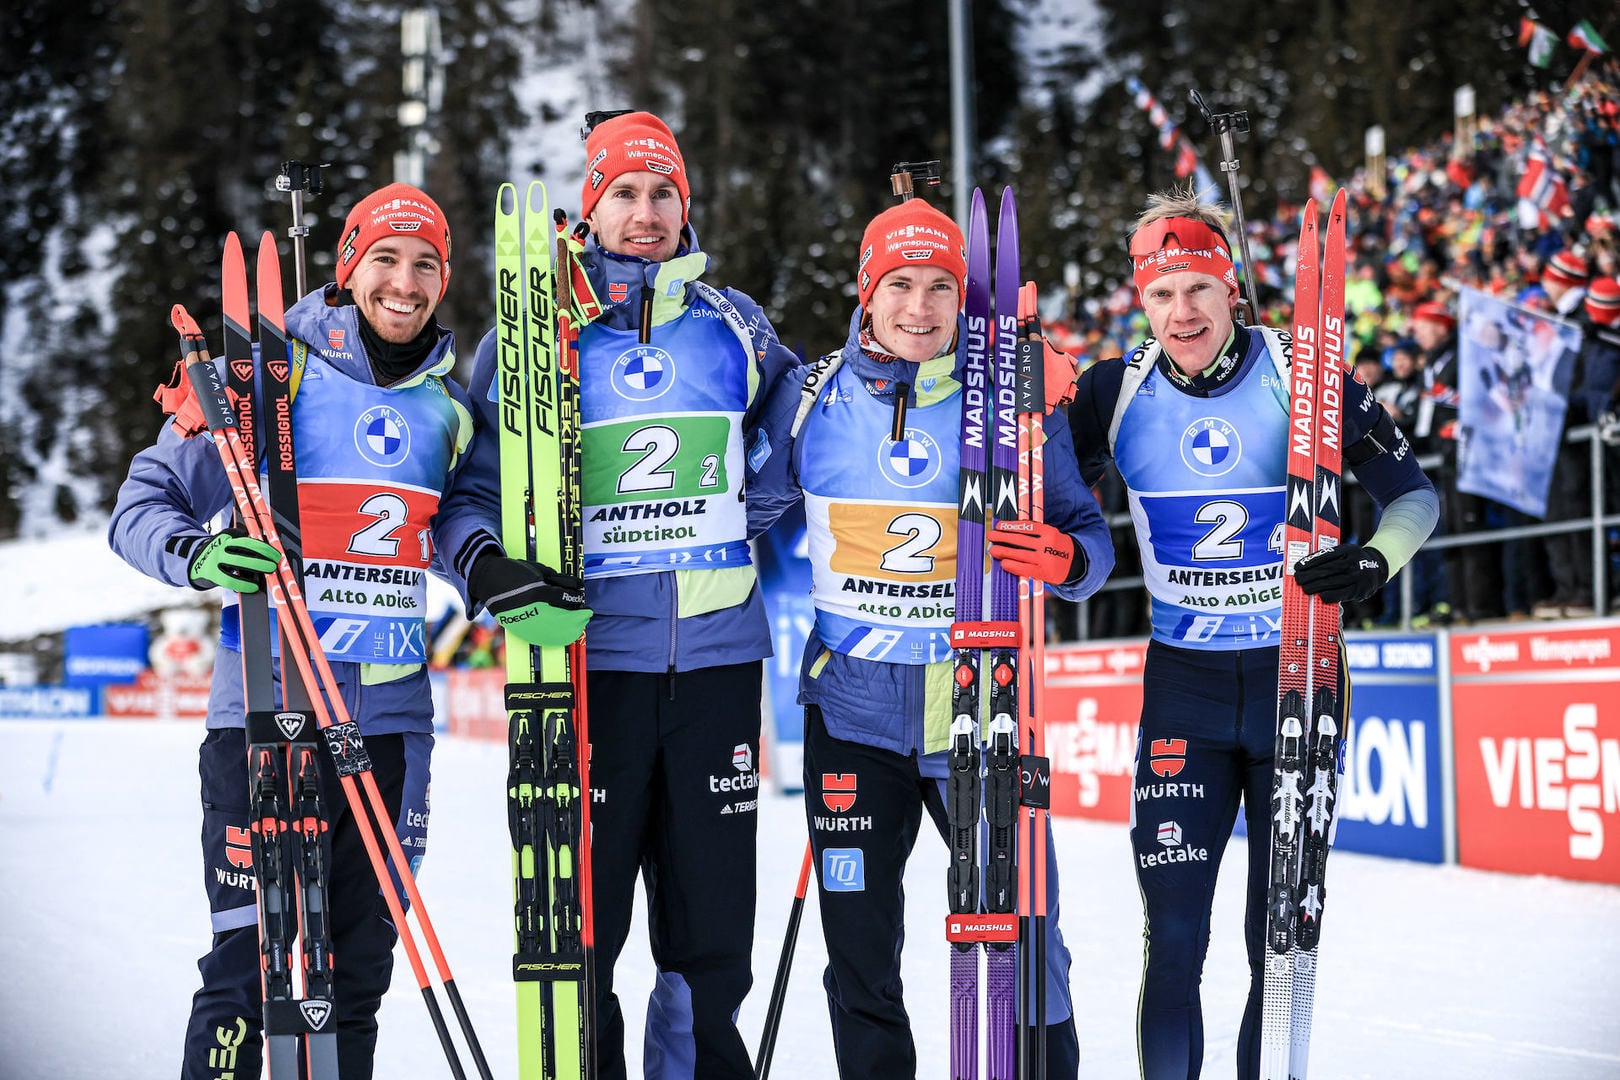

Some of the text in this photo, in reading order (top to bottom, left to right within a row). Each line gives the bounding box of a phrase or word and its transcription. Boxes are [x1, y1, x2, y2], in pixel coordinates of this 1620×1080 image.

[886, 240, 949, 252] Wärmepumpen
[500, 268, 523, 438] FISCHER
[530, 266, 555, 437] FISCHER
[802, 354, 839, 397] JOKA
[965, 316, 985, 448] MADSHUS
[998, 314, 1017, 448] MADSHUS
[1293, 325, 1315, 457] MADSHUS
[1322, 313, 1341, 450] MADSHUS
[275, 393, 294, 471] ROSSIGNOL
[561, 382, 572, 444] LEKI
[1187, 420, 1232, 438] BMW
[616, 424, 681, 495] 2
[699, 454, 720, 488] 2
[345, 493, 432, 563] 2 1
[588, 499, 707, 523] ANTHOLZ
[1191, 499, 1250, 562] 2
[879, 513, 943, 574] 2
[842, 577, 956, 599] ANTERSEL
[499, 606, 540, 625] Roeckl
[968, 630, 1016, 638] MADSHUS
[508, 691, 572, 700] FISCHER
[709, 768, 760, 793] tectak
[1135, 782, 1205, 802] WÜRTH
[814, 815, 873, 832] WÜRTH
[1140, 843, 1208, 870] tectake
[964, 923, 1013, 932] MADSHUS
[516, 963, 582, 972] FISCHER
[207, 1016, 248, 1080] GE
